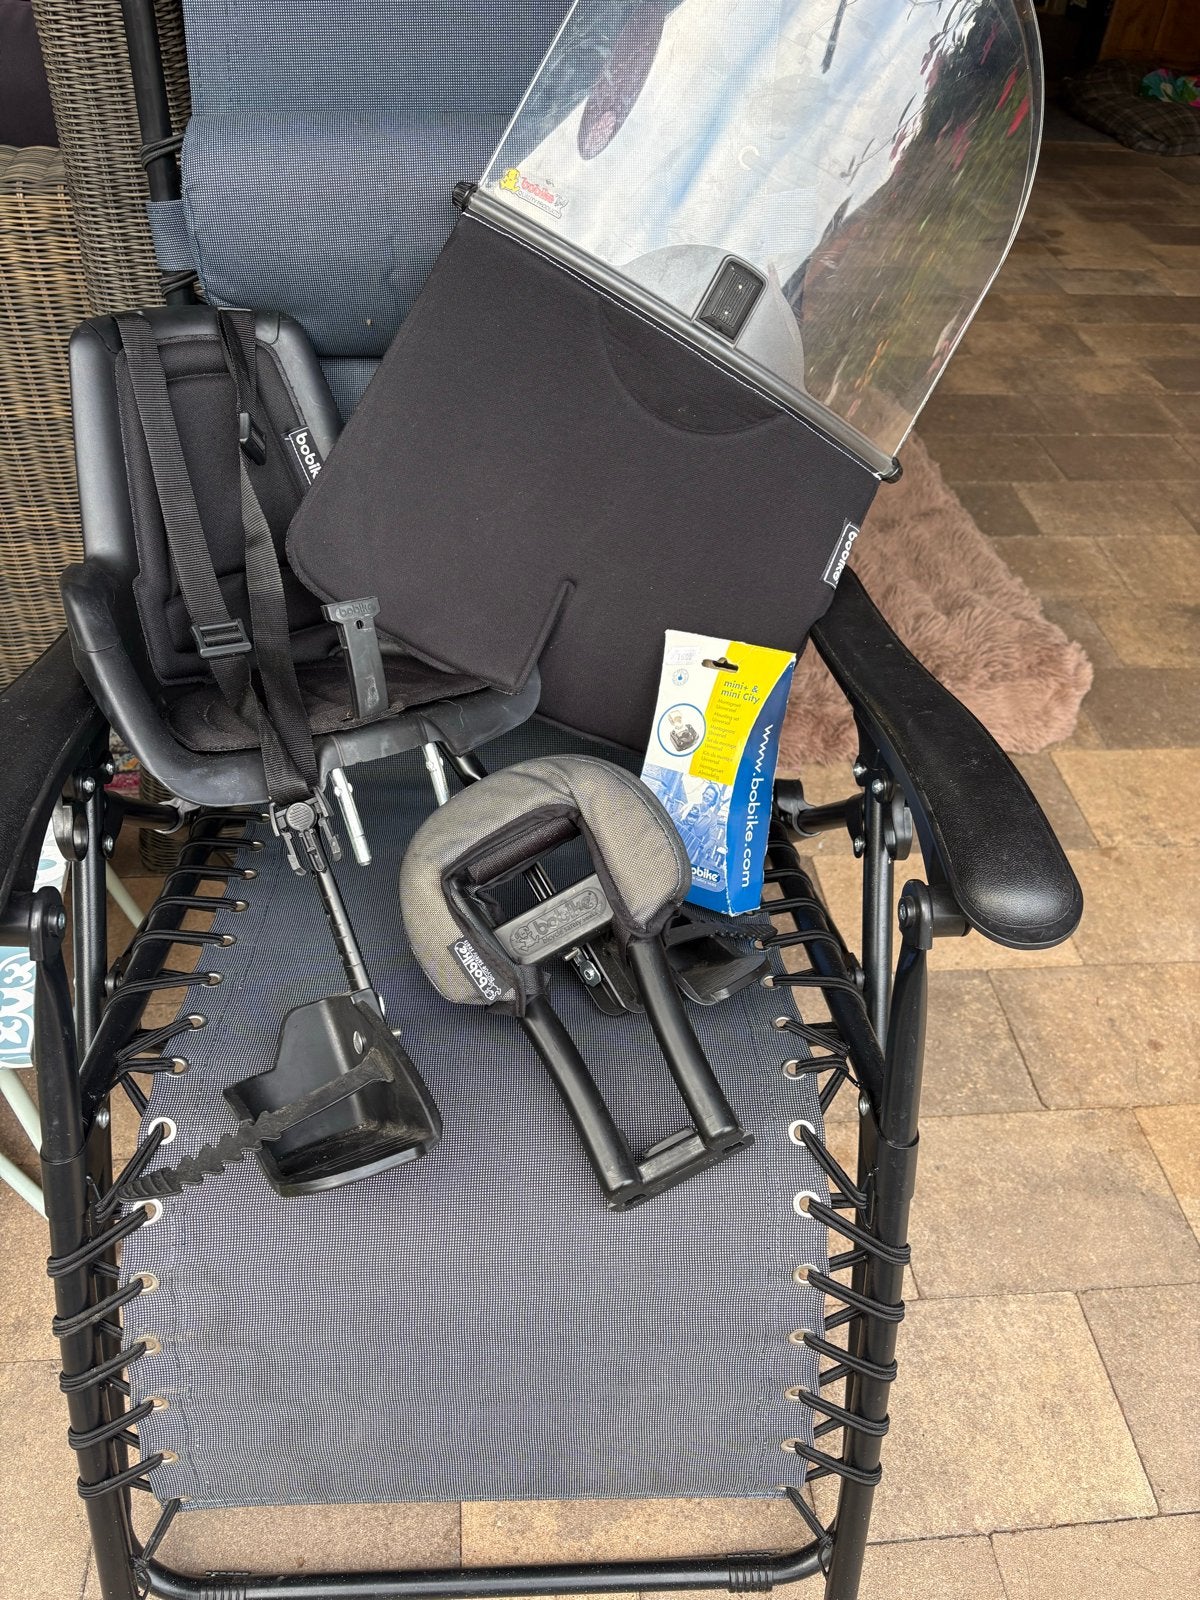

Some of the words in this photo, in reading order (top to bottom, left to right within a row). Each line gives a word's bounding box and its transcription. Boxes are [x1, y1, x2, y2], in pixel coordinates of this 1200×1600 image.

[296, 432, 322, 479] bobik
[721, 689, 741, 699] mini
[743, 693, 760, 705] City
[752, 685, 759, 693] &
[741, 724, 774, 888] www.bobike.com
[691, 866, 719, 882] obike
[534, 894, 592, 935] bobike
[457, 945, 488, 988] bobike
